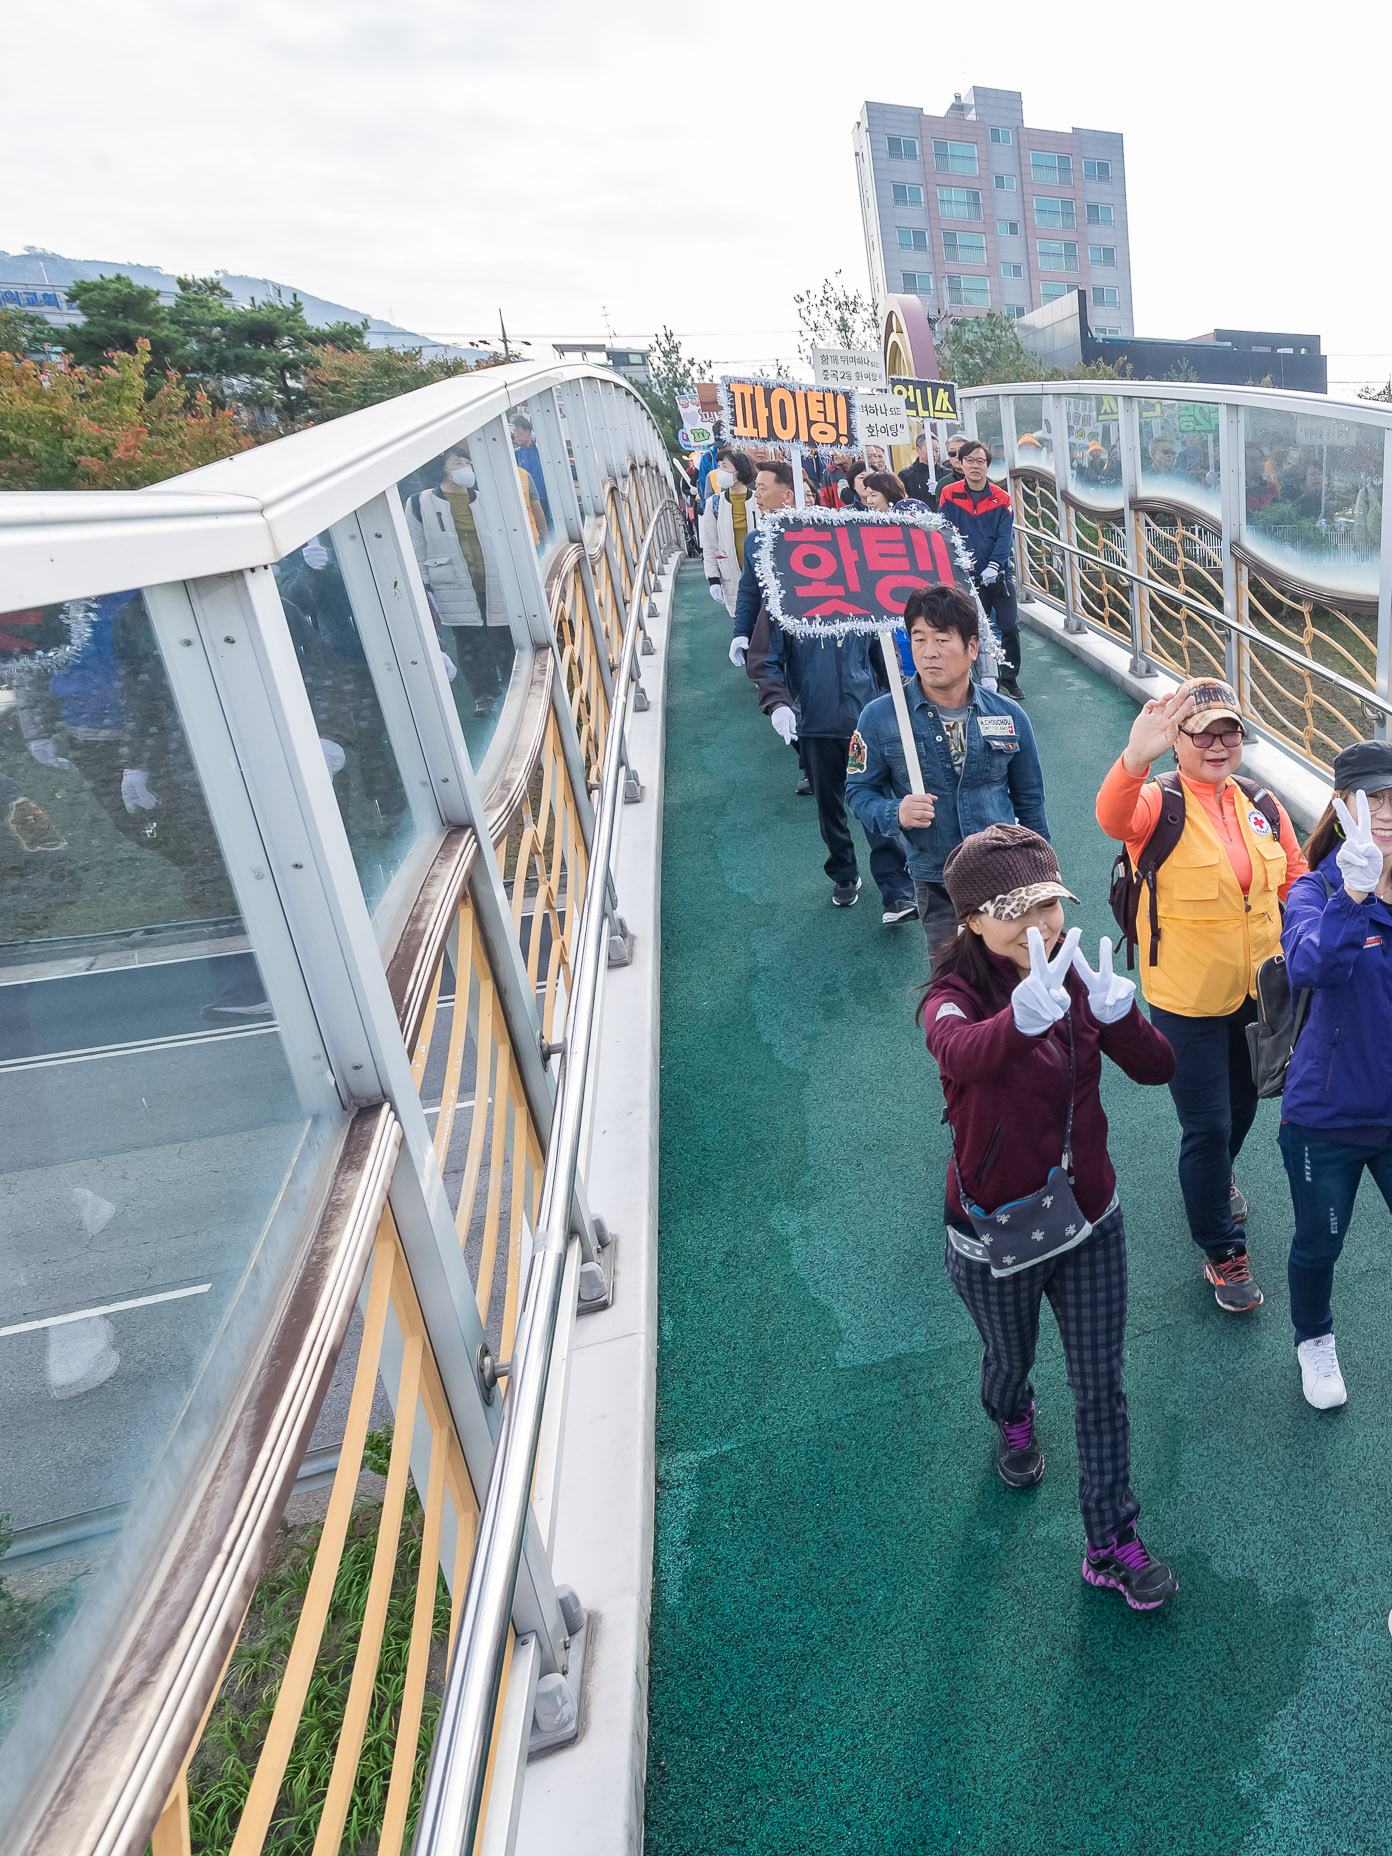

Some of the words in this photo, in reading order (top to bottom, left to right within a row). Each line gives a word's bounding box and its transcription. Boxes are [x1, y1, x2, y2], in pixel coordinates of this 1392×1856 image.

[0, 290, 62, 311] 의교회
[820, 354, 838, 365] 함께
[822, 370, 852, 381] 중곡2동
[893, 384, 957, 419] 언니쓰
[730, 383, 849, 445] 파이팅!
[889, 406, 901, 416] 되는
